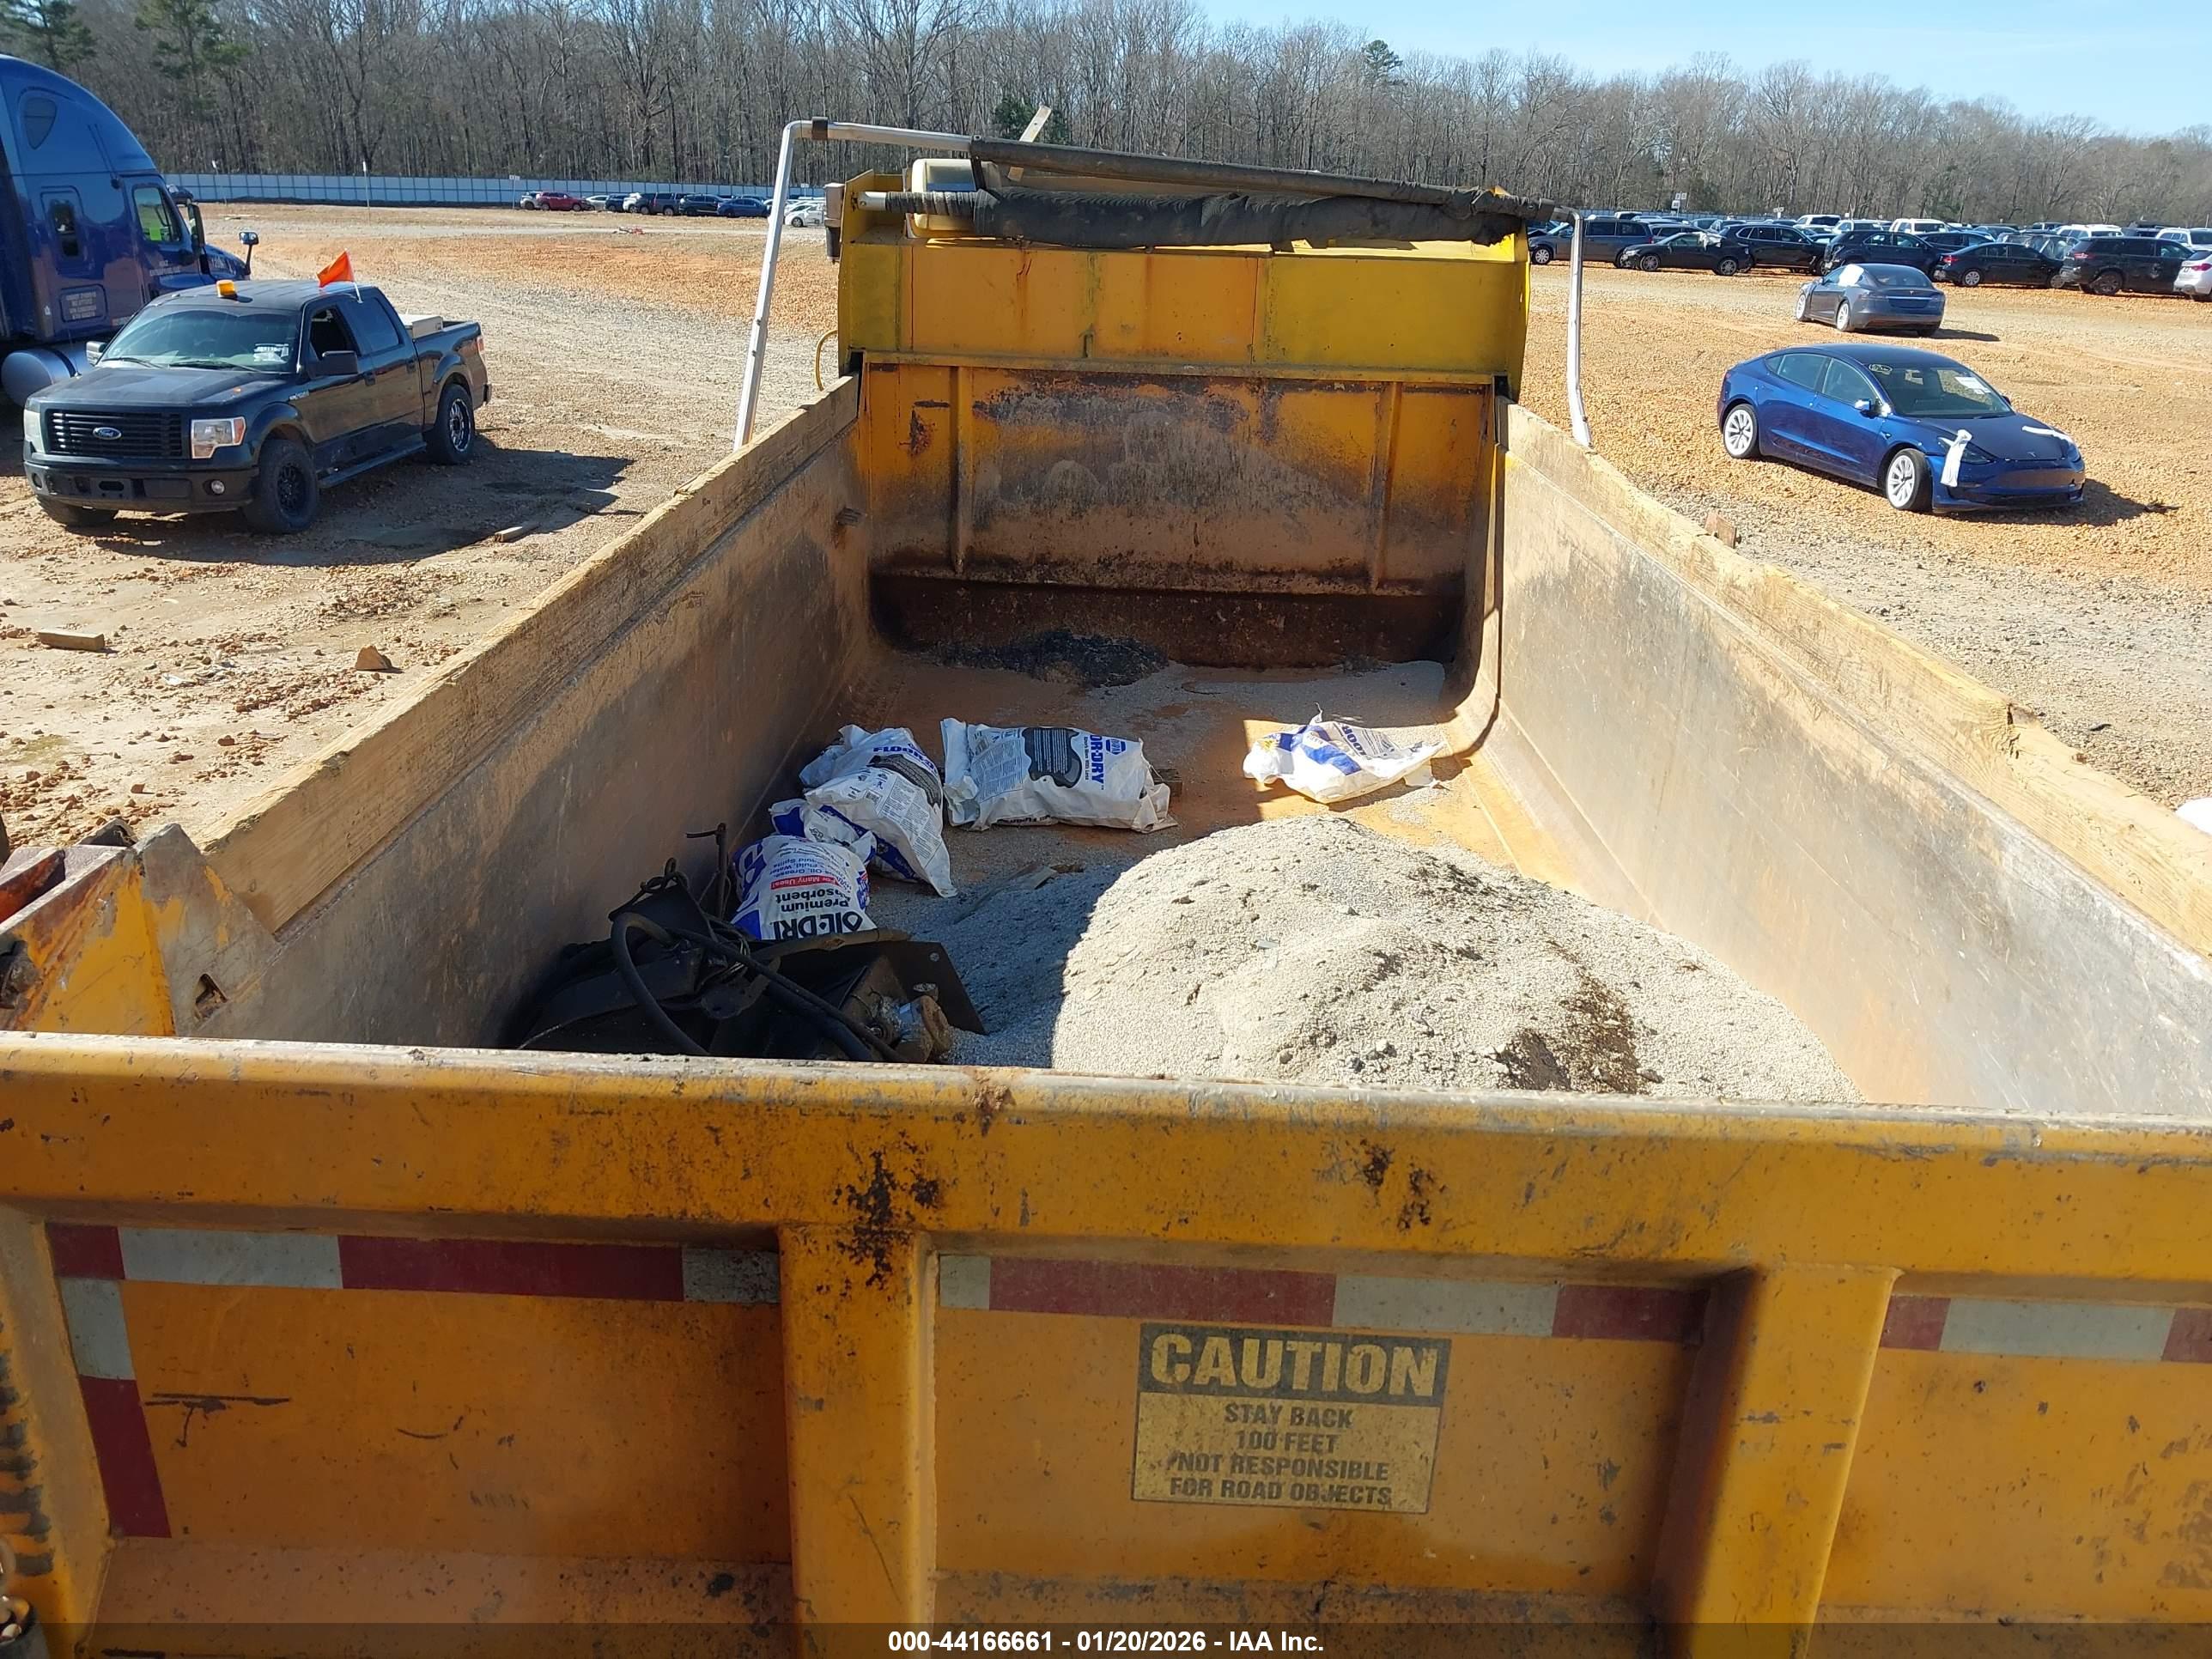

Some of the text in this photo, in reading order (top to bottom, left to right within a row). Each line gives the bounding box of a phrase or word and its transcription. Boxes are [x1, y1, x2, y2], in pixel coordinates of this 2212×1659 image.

[781, 897, 849, 914] Premium
[1151, 1332, 1438, 1397] CAUTION
[1224, 1401, 1354, 1429] STAY BACK
[1236, 1431, 1341, 1455] 100 FEET
[1176, 1452, 1389, 1481] NOT RESPONSIBLE
[1170, 1477, 1393, 1506] FOR ROAD OBJECTS
